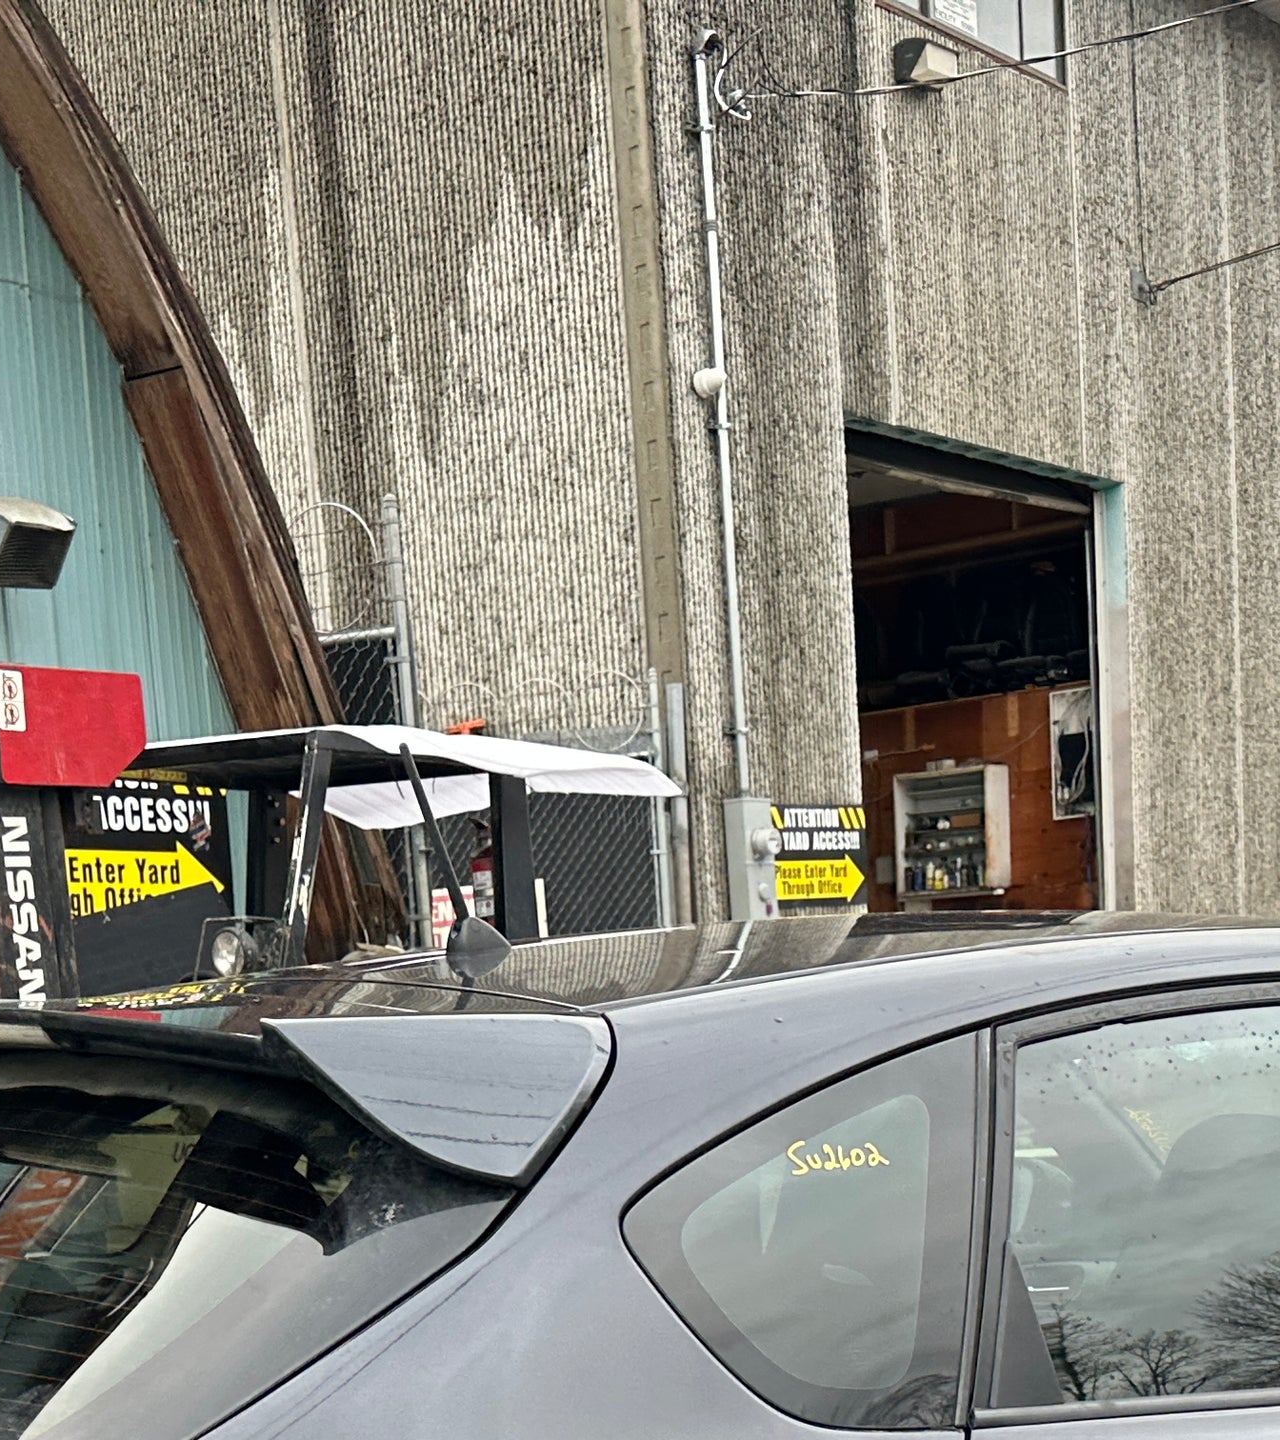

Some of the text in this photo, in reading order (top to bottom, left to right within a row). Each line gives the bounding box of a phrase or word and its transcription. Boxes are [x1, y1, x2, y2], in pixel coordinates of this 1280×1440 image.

[783, 808, 840, 828] ATTENTION
[782, 831, 809, 851] YARD
[69, 857, 180, 885] Enter Yard
[775, 864, 848, 880] Please Enter Yard
[782, 881, 843, 897] Through Office
[1, 815, 47, 1002] NISSAN
